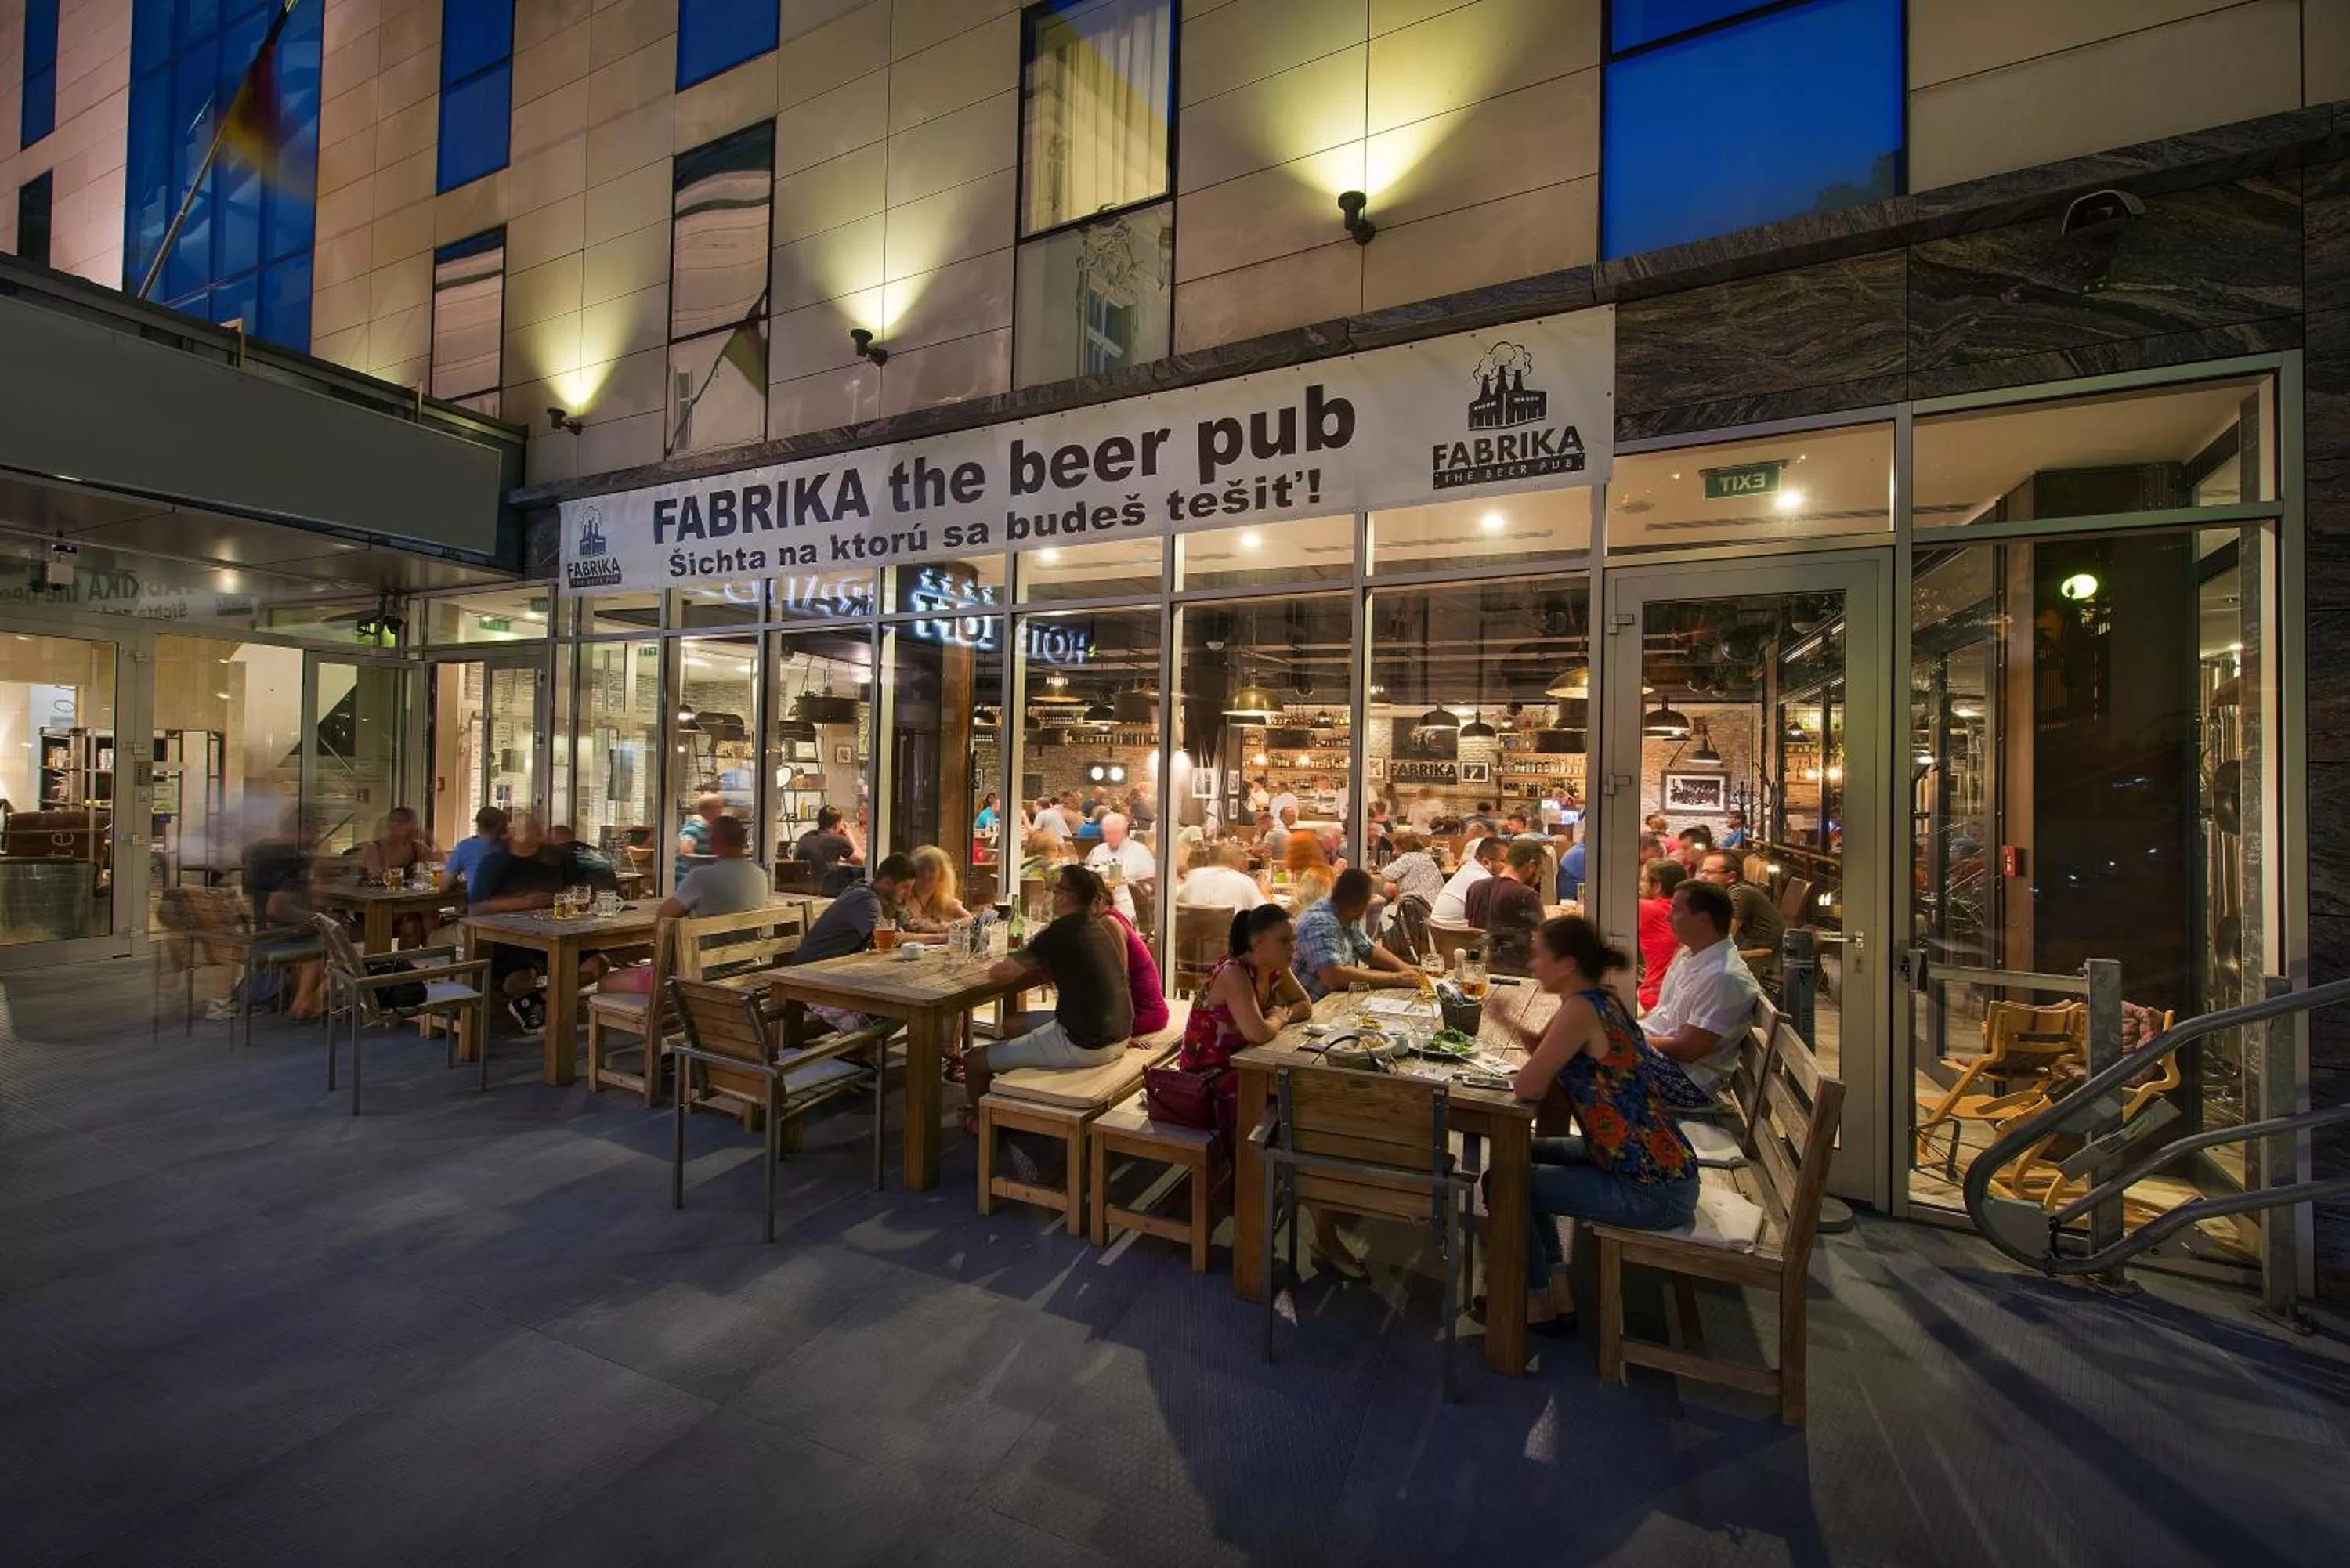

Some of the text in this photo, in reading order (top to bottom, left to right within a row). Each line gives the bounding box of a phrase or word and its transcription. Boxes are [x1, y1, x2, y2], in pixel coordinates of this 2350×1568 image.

[653, 384, 1356, 545] FABRIKA the beer pub
[1433, 425, 1585, 471] FABRIKA
[1444, 457, 1572, 483] THE BEER PUB
[669, 468, 1321, 577] Šichta na ktorú sa budeš tešiť!
[566, 557, 621, 580] FABRIKA
[1391, 763, 1457, 777] FABRIKA
